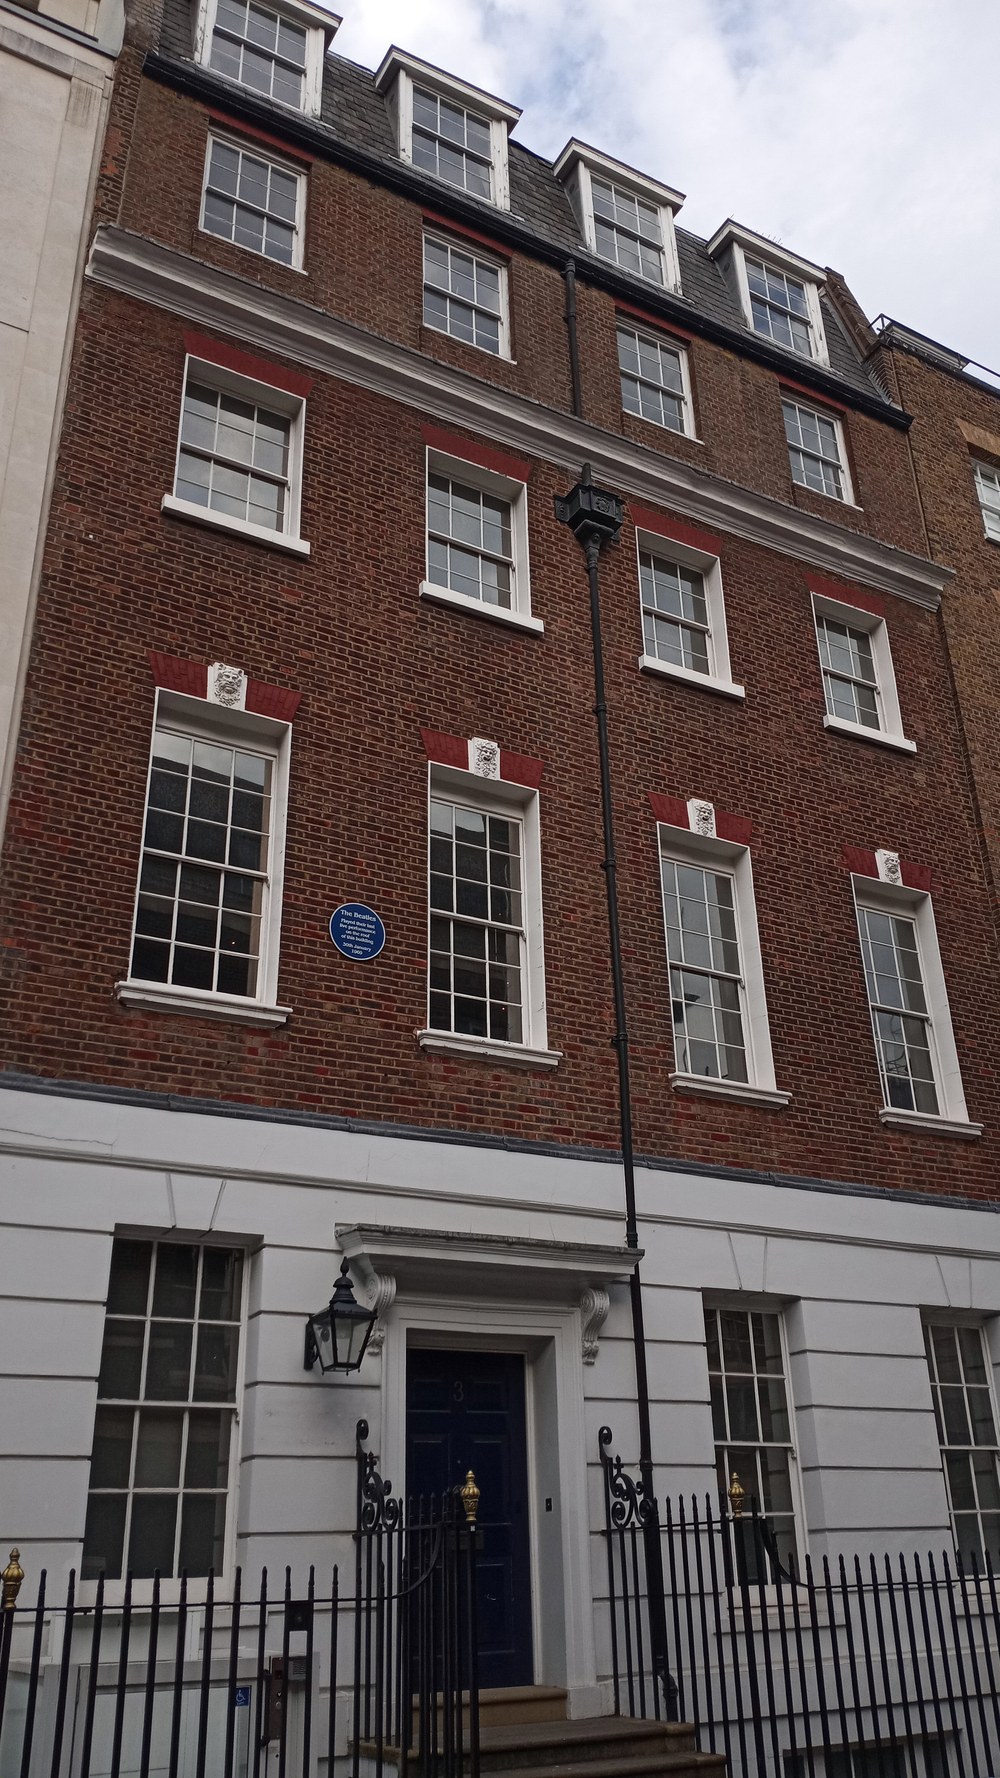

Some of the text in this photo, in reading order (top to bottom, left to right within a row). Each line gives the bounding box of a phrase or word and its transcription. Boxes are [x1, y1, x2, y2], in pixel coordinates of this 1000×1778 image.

[354, 912, 376, 921] Beatles
[348, 925, 376, 934] performance
[453, 1381, 464, 1402] 3
